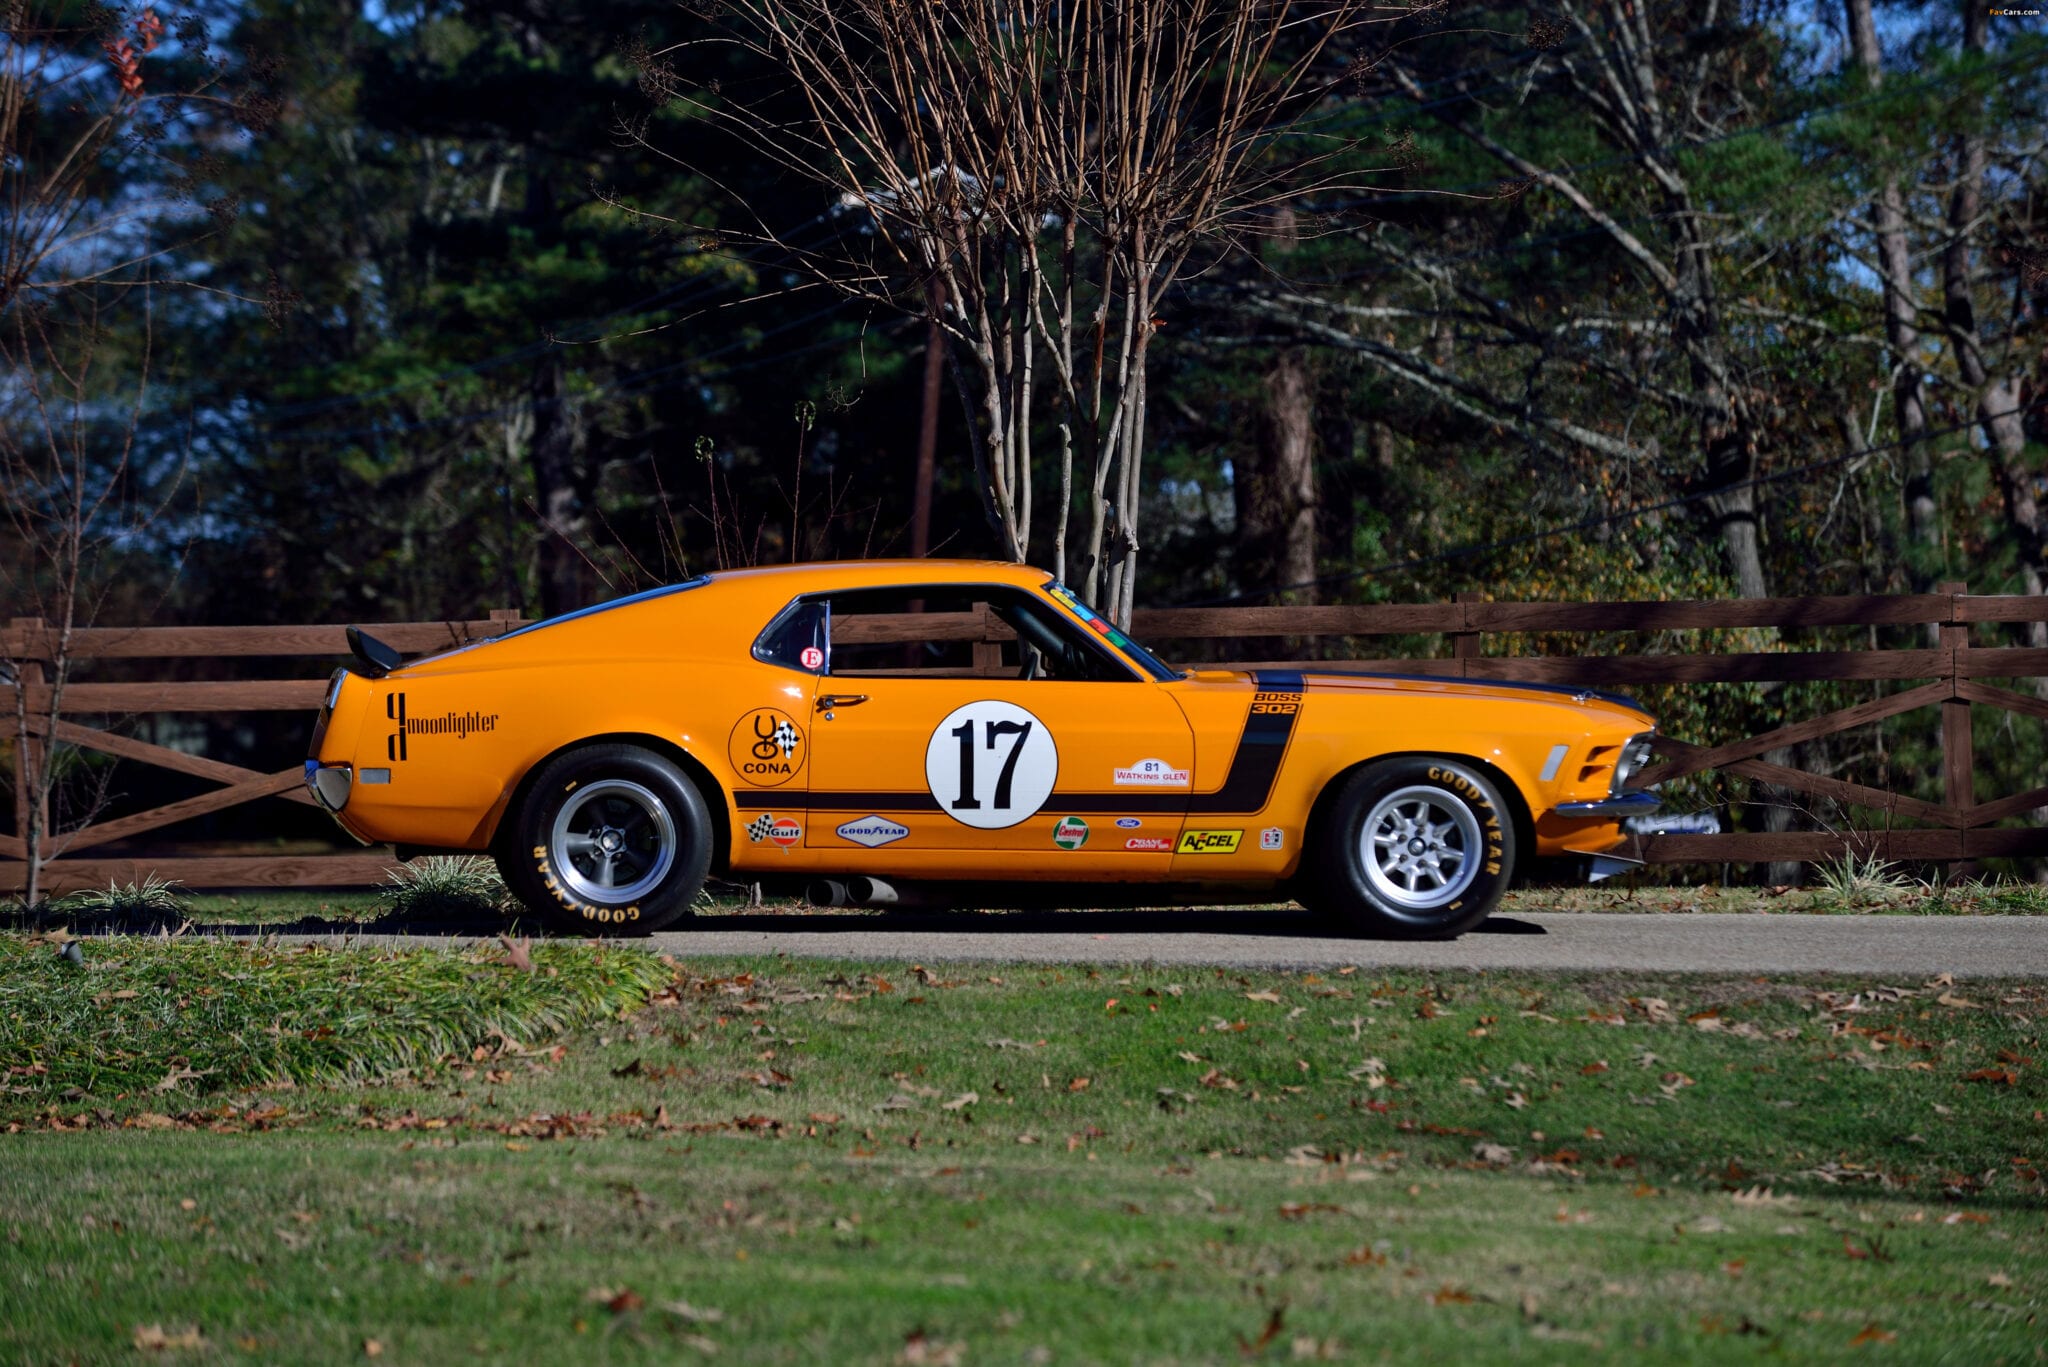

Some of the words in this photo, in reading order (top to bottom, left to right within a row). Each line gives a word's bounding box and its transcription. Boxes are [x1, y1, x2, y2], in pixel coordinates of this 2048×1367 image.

[806, 651, 818, 665] E
[1254, 693, 1302, 701] BOSS
[1252, 704, 1297, 714] 302
[407, 711, 499, 739] moonlighter
[743, 763, 791, 774] CONA
[952, 719, 1032, 809] 17
[1145, 762, 1159, 772] 81
[1117, 771, 1159, 780] WATKINS
[1119, 819, 1137, 827] Ford
[1427, 766, 1503, 875] GOODYEAR
[770, 828, 800, 837] Gulf
[840, 826, 905, 836] GOODYEAR
[1058, 825, 1086, 837] Castrol
[1184, 833, 1235, 850] ACCEL
[533, 844, 640, 923] GOODYEAR
